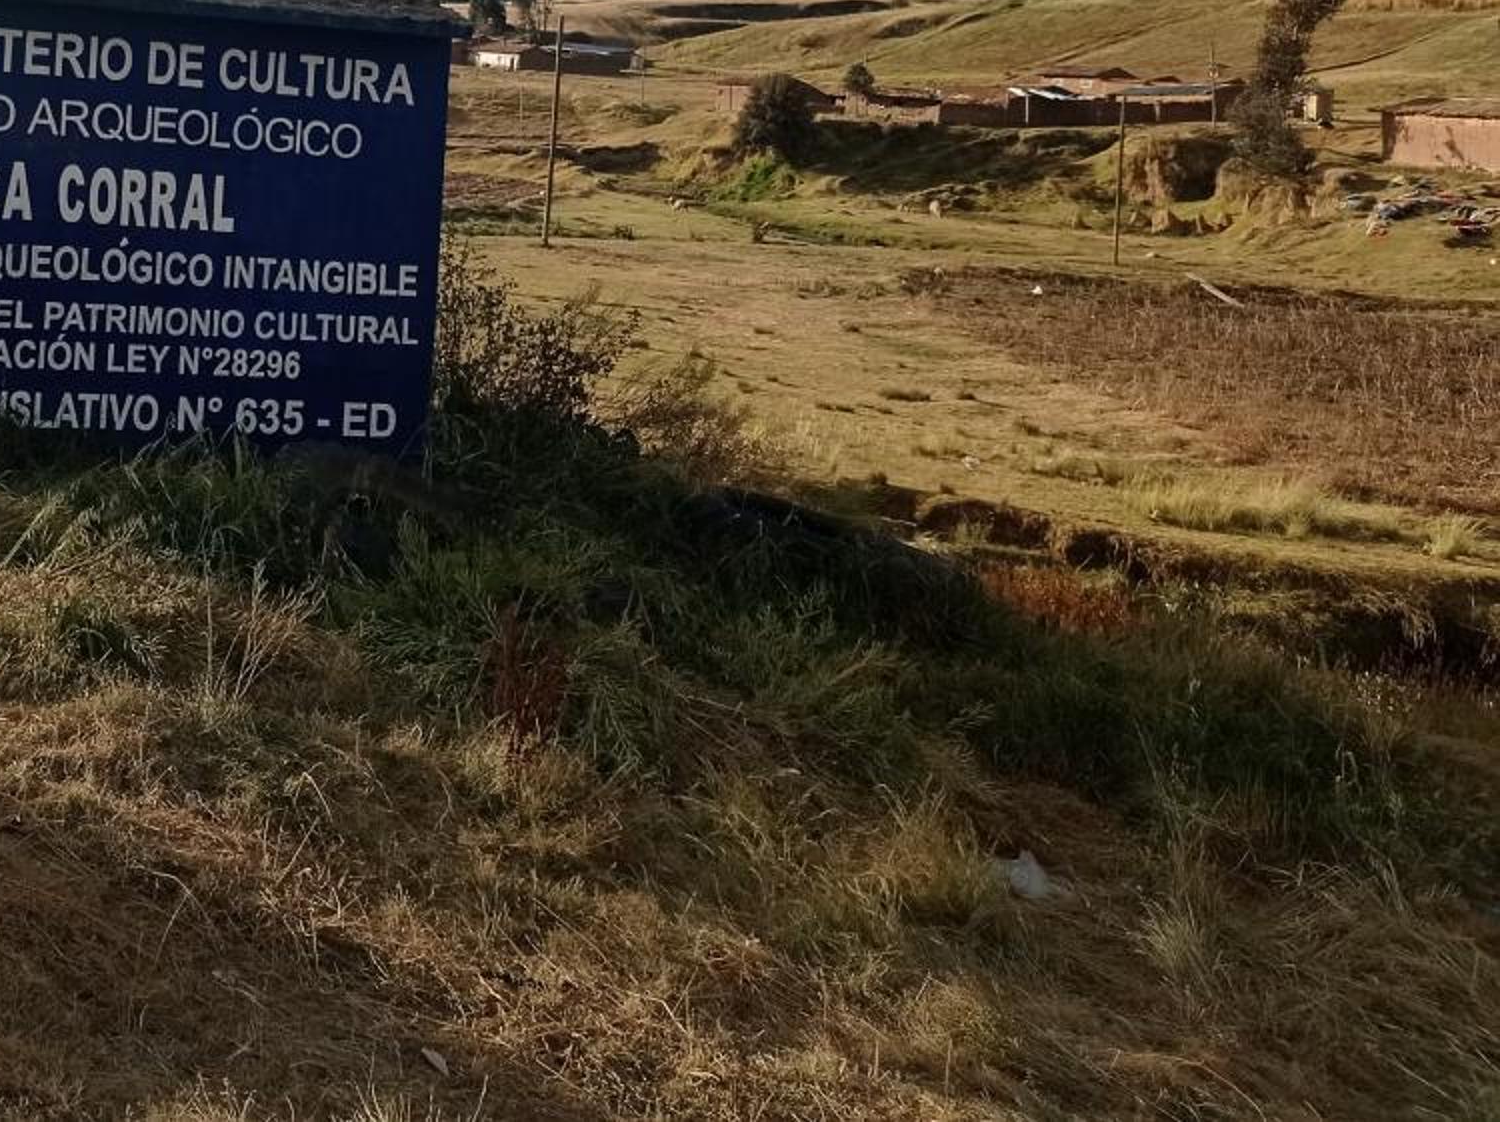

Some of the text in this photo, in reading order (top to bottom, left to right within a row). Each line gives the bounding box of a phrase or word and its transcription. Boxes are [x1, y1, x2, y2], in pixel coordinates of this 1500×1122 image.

[147, 42, 205, 88] DE
[219, 49, 415, 106] CULTURA
[27, 97, 363, 159] ARQUEOLÓGICO
[58, 164, 235, 233] CORRAL
[223, 255, 419, 297] INTANGIBLE
[43, 301, 245, 339] PATRIMONIO
[254, 311, 419, 346] CULTURAL
[106, 343, 171, 374] LEY
[235, 397, 305, 435] 635
[342, 402, 397, 438] ED
